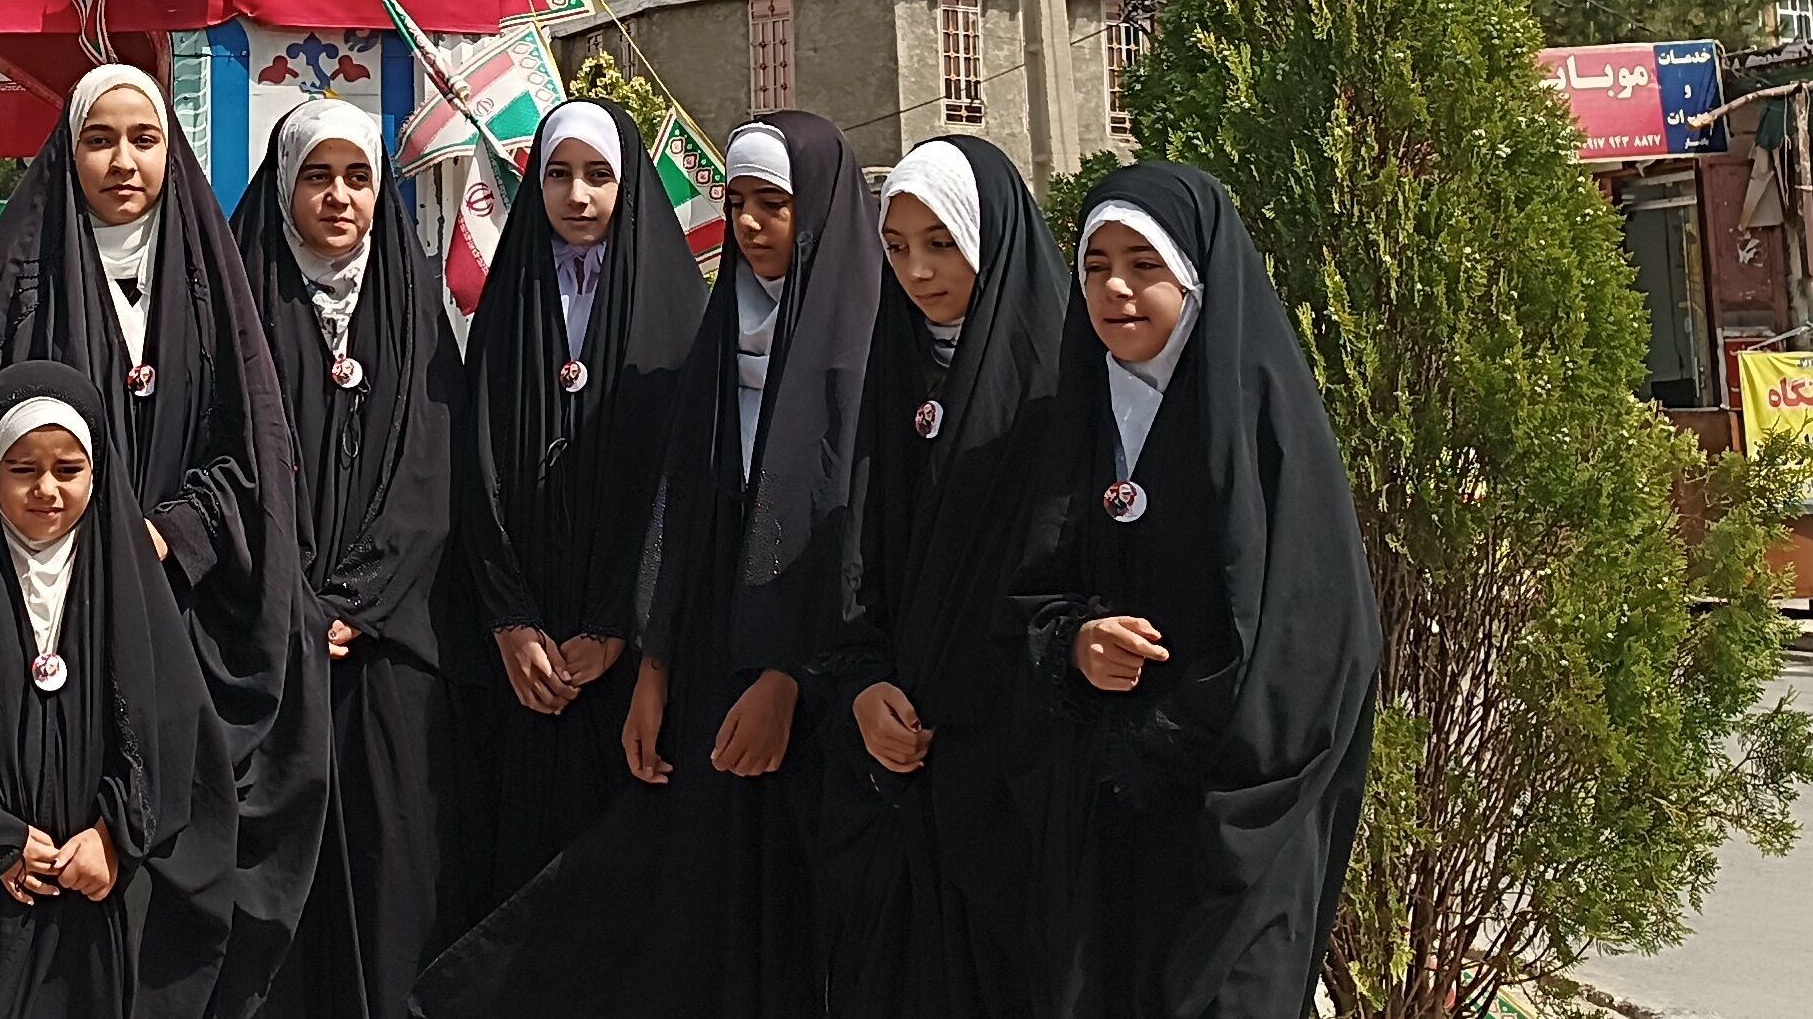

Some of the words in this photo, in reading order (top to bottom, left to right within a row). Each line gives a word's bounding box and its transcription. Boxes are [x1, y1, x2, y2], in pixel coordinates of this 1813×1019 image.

[1658, 48, 1711, 66] خدمات
[1539, 54, 1649, 99] موبای
[1684, 84, 1692, 99] و
